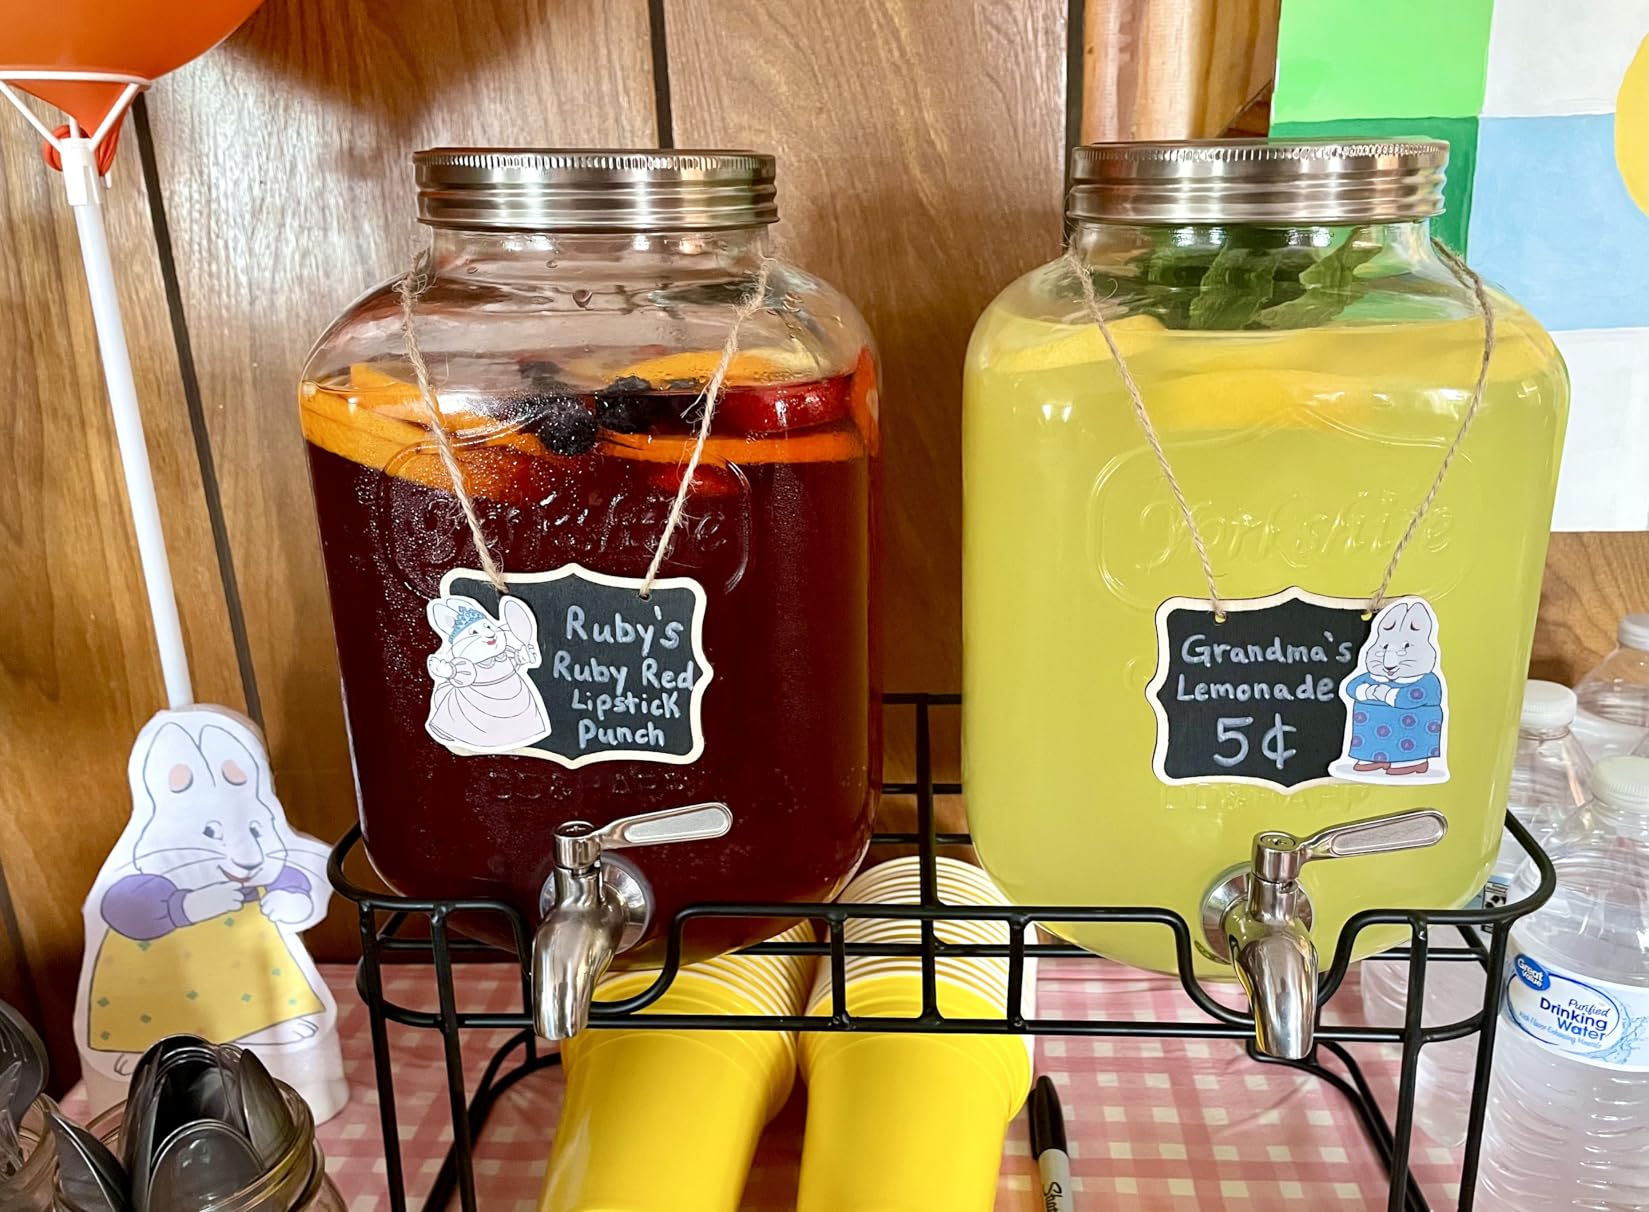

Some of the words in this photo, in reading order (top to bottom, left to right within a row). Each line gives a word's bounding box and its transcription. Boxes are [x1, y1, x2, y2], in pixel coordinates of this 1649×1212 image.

[566, 604, 685, 657] Ruby's
[1181, 630, 1353, 668] Grandma's
[553, 650, 629, 696] Ruby
[641, 657, 695, 692] Red
[1176, 673, 1335, 702] Lemonade
[578, 718, 665, 750] Punch
[1517, 958, 1544, 982] Great
[1540, 996, 1608, 1032] Drinking
[1568, 998, 1611, 1018] Purified
[1557, 1017, 1606, 1041] Water
